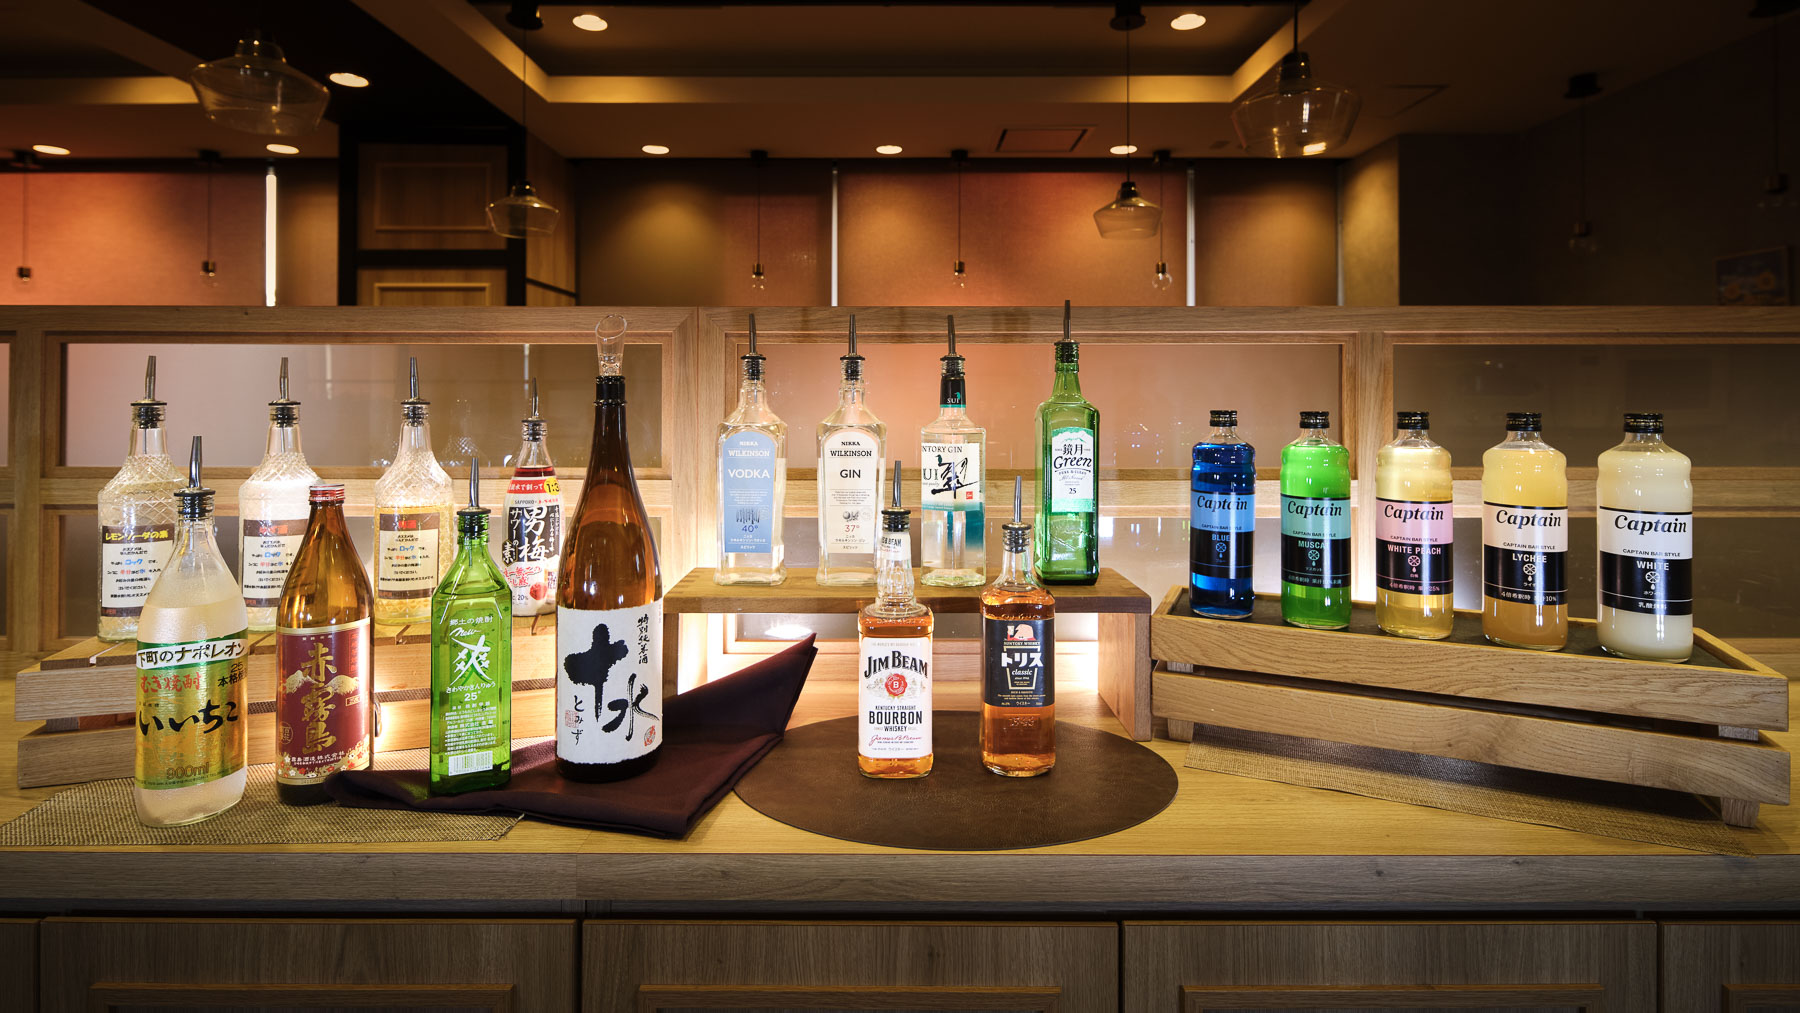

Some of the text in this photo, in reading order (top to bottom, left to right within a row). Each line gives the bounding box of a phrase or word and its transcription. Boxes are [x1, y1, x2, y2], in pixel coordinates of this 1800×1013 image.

[948, 446, 963, 454] GIN
[1063, 443, 1083, 456] 鏡月
[1053, 455, 1092, 469] Green
[727, 469, 771, 479] VODKA
[840, 469, 862, 479] GIN
[931, 457, 979, 500] 翠
[1069, 487, 1077, 495] 25
[1197, 495, 1248, 512] Captain
[1287, 500, 1342, 518] Captain
[1384, 504, 1444, 523] Captain
[1496, 510, 1561, 529] Captain
[742, 524, 759, 533] 40°
[844, 524, 860, 533] 37°
[1614, 514, 1687, 535] Captain
[502, 510, 522, 564] サワーの 素
[517, 506, 550, 562] 男梅
[1212, 533, 1231, 542] BLUE
[1387, 544, 1442, 555] WHITE PEACH
[1502, 541, 1527, 549] CAPTAIN
[1622, 548, 1650, 556] CAPTAIN
[125, 558, 143, 566] ロック
[1512, 552, 1548, 563] LYCHEE
[1636, 560, 1670, 571] WHITE
[449, 616, 493, 626] 郷土の焼酎
[638, 614, 650, 664] 特別純米酒
[138, 641, 246, 668] 下町のナポレオン
[450, 634, 493, 687] 爽
[1001, 652, 1044, 668] トリス
[230, 661, 244, 673] 25
[864, 650, 928, 679] JIM BEAM
[1012, 668, 1033, 676] classic
[140, 671, 203, 693] むぎ焼酎
[300, 642, 338, 754] 赤霧島
[138, 699, 240, 736] いいちこ
[571, 695, 584, 746] とみず
[868, 710, 922, 724] BOURBON
[166, 761, 210, 780] 900ml
